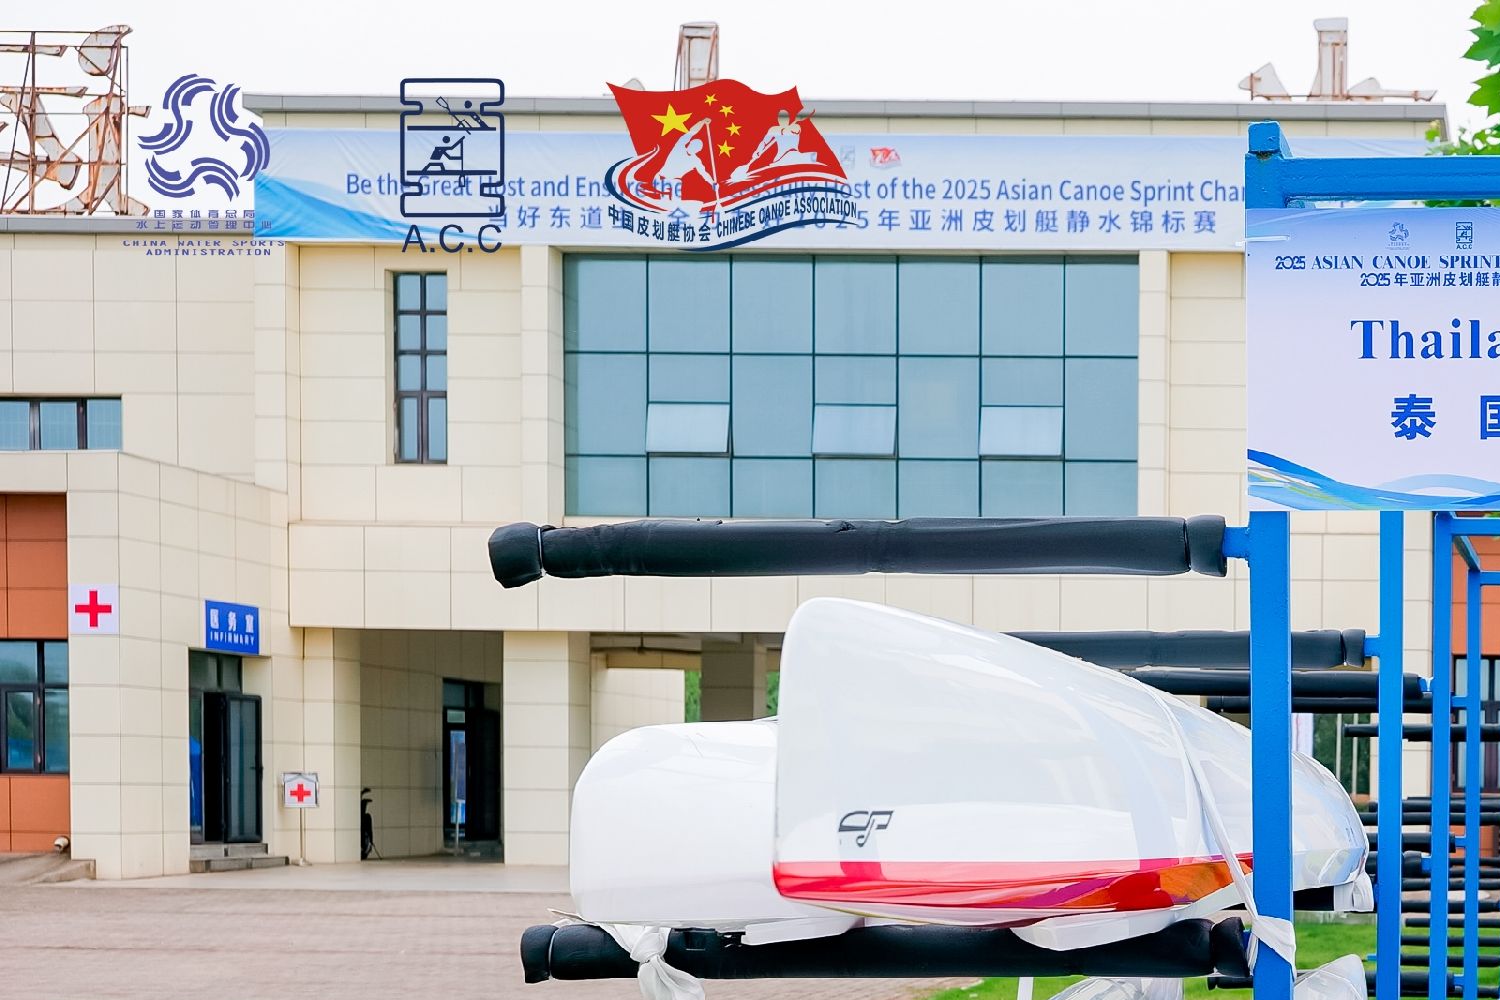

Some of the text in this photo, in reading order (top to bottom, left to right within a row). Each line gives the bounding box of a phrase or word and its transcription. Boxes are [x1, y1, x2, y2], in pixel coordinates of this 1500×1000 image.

[346, 174, 372, 195] Be
[531, 172, 569, 197] and
[876, 177, 899, 201] of
[903, 177, 936, 201] the
[942, 178, 991, 201] 2025
[996, 177, 1052, 202] Asian
[1059, 179, 1125, 202] Canoe
[1130, 178, 1195, 207] Sprint
[1200, 179, 1246, 202] Cha
[1275, 255, 1306, 270] 2025
[1311, 255, 1364, 269] ASIAN
[1372, 255, 1431, 269] CANOE
